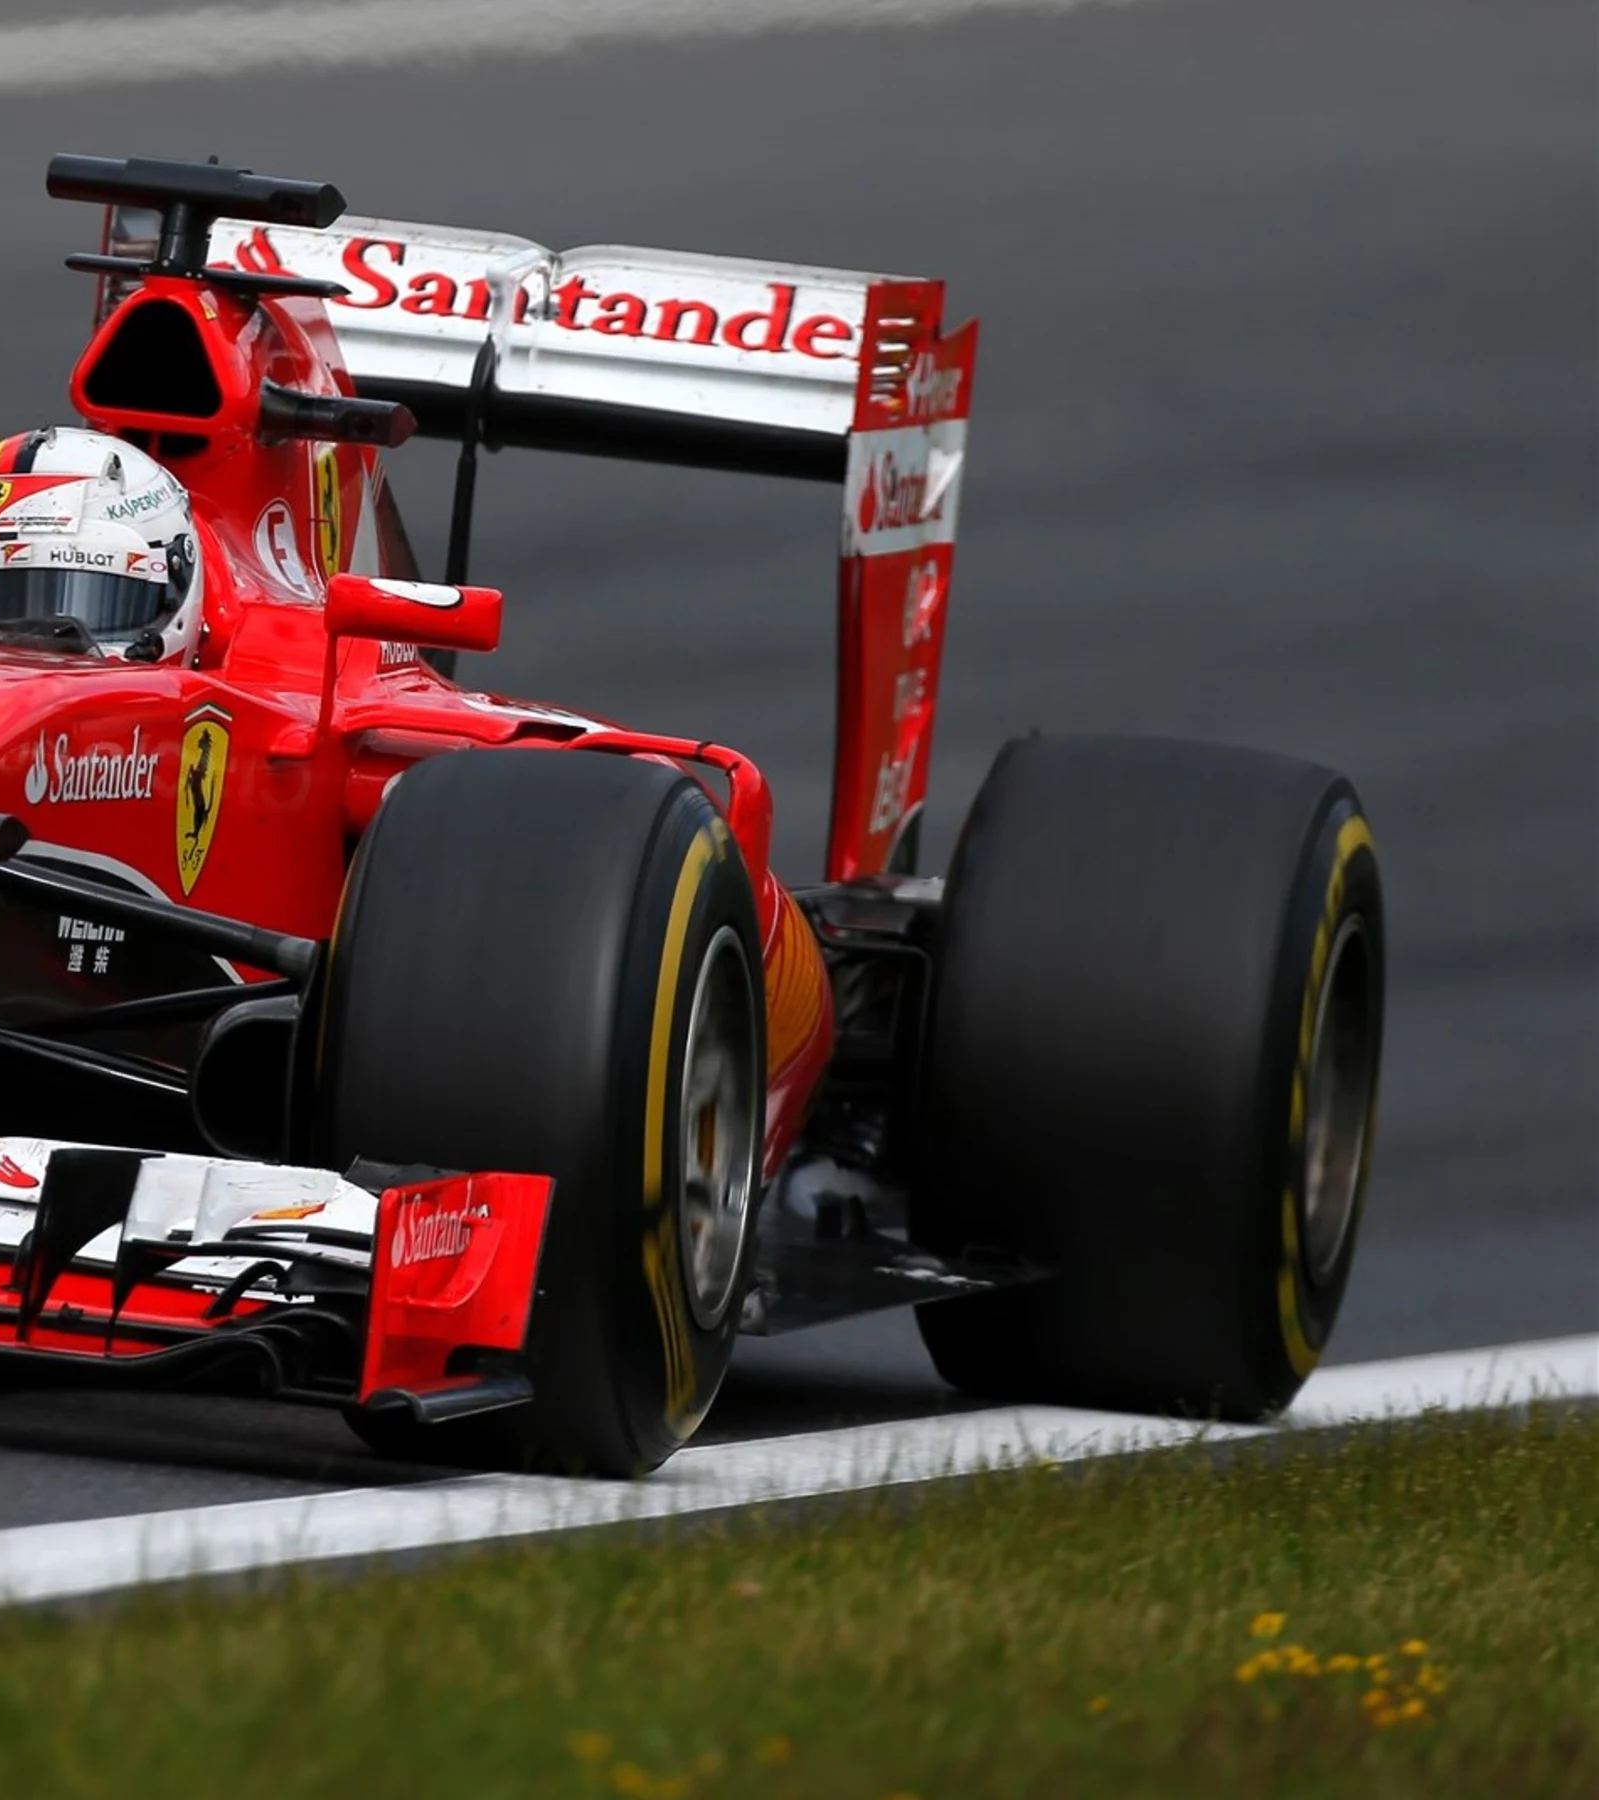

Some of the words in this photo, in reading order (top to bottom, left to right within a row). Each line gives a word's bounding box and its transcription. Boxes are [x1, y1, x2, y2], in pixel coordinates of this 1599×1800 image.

[331, 237, 861, 362] Santande
[50, 549, 115, 568] HUBLOT
[50, 724, 158, 804] Santander
